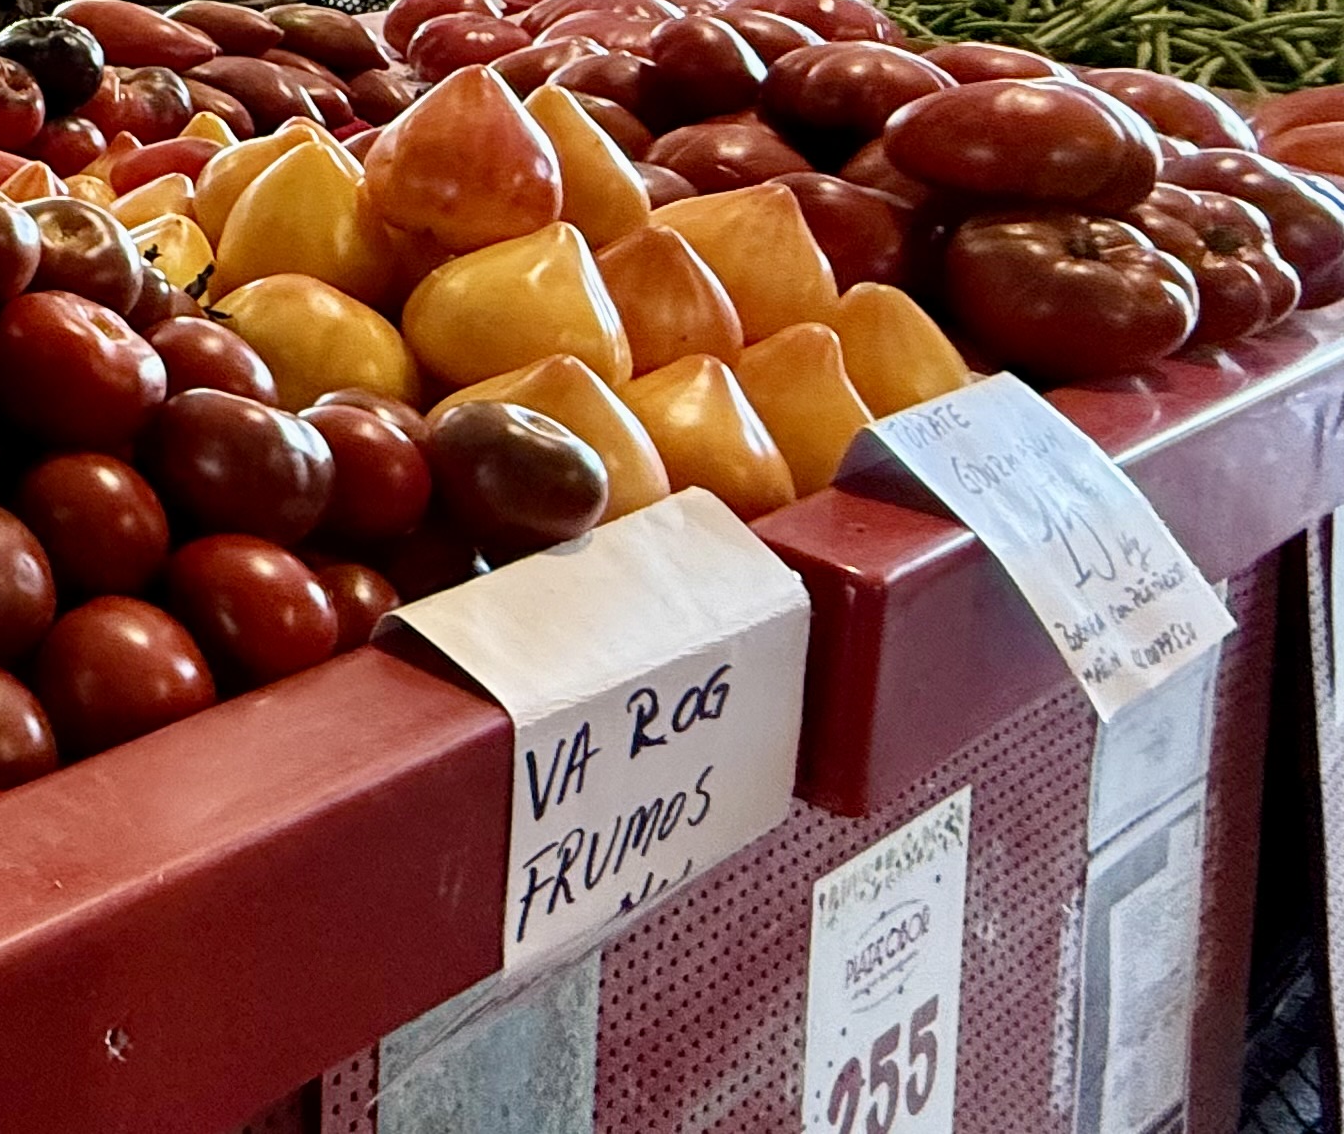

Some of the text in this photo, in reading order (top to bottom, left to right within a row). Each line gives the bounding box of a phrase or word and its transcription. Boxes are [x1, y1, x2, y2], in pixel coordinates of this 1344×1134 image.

[525, 664, 733, 822] VA ROG
[516, 765, 715, 943] FRUMOS
[827, 994, 940, 1134] 255
